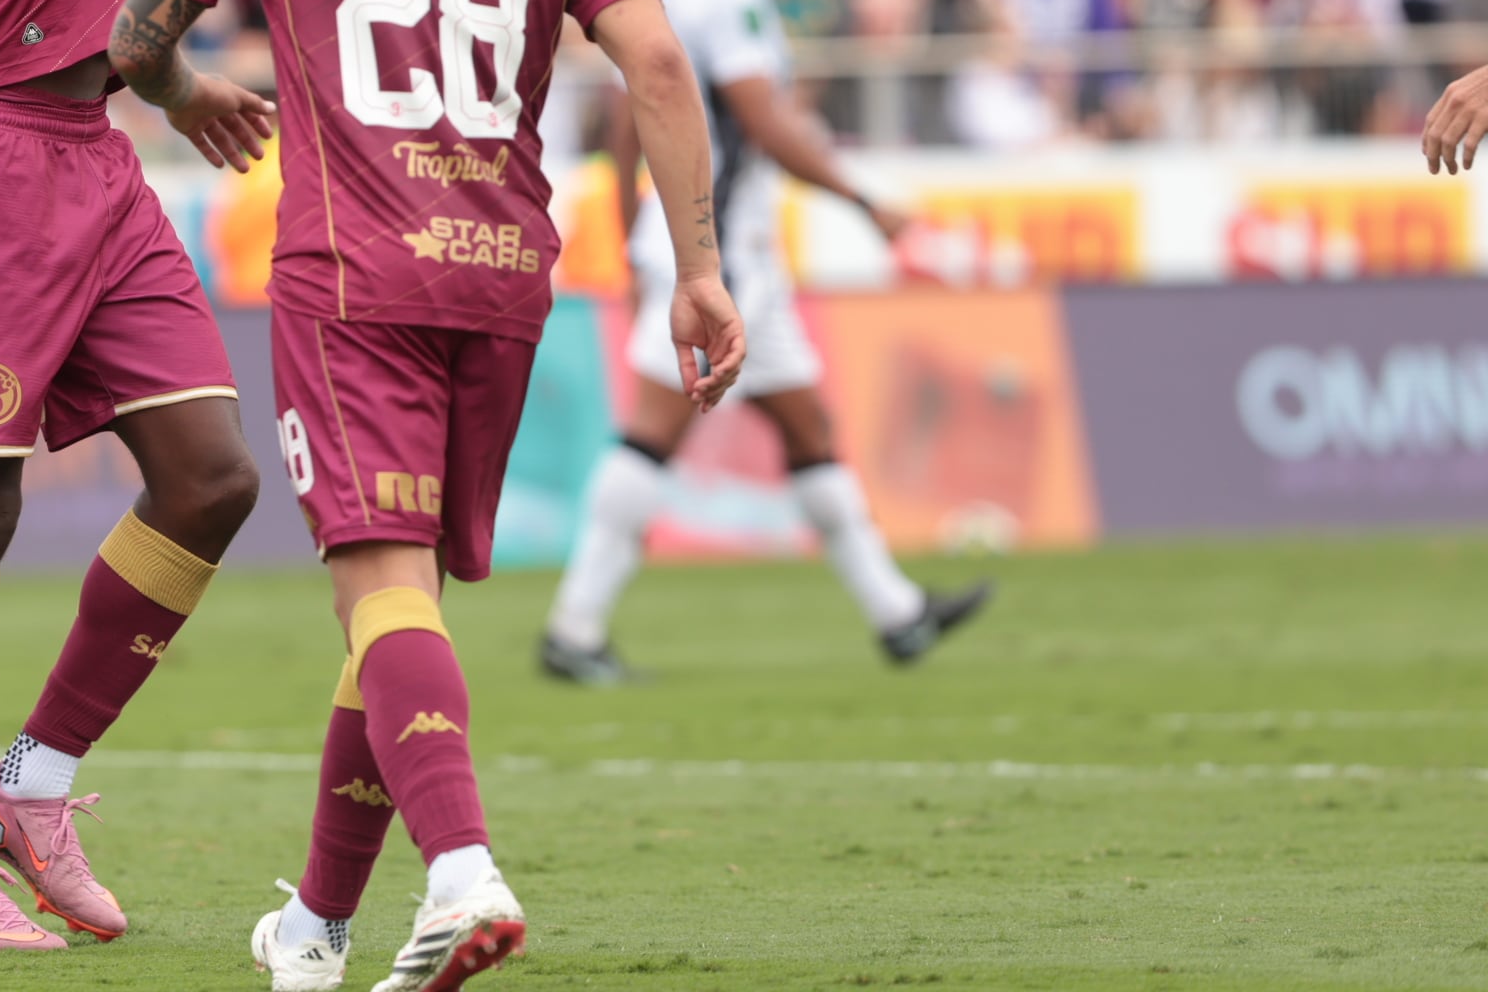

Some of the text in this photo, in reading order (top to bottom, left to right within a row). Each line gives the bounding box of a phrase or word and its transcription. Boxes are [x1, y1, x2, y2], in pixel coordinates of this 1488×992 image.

[429, 215, 522, 249] STAR
[448, 238, 540, 273] CARS
[276, 407, 315, 497] 8
